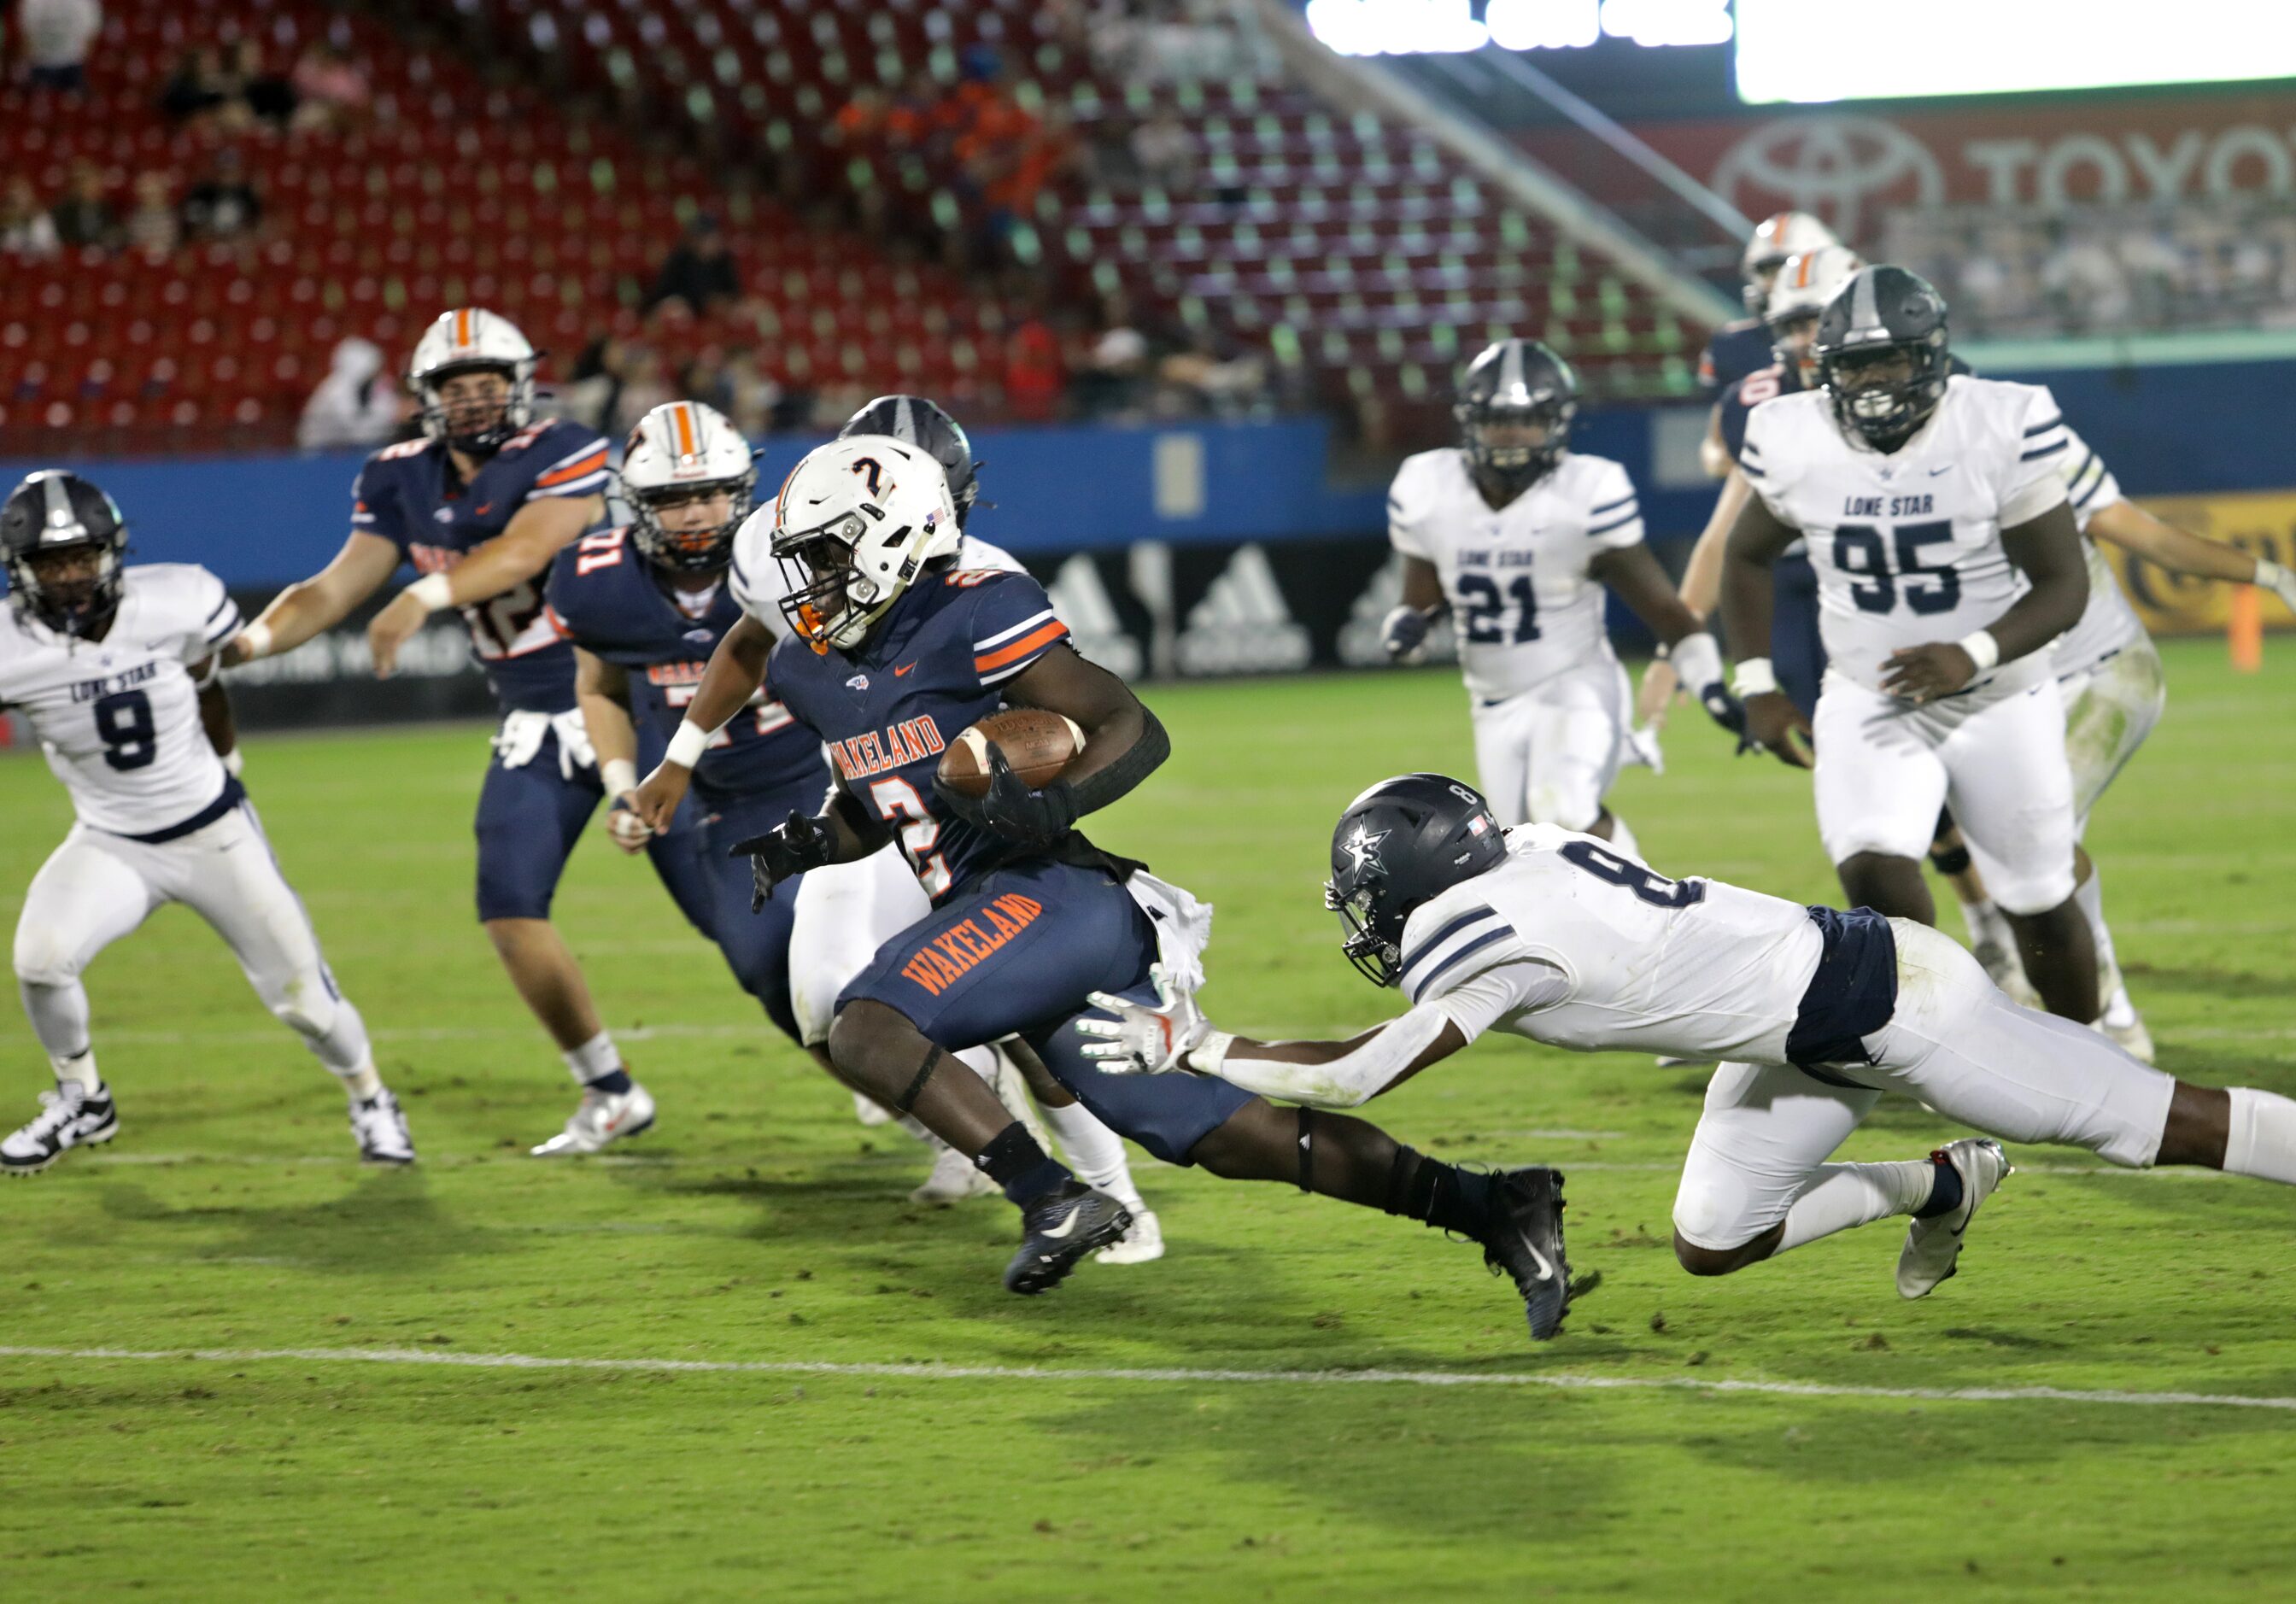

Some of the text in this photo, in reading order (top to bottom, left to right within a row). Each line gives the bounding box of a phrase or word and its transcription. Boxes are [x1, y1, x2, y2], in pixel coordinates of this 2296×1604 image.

[1965, 125, 2296, 208] TOYO
[852, 456, 896, 498] 2
[1844, 494, 1934, 516] LONE STAR
[1832, 519, 1962, 616] 95
[1457, 574, 1541, 644] 21
[94, 688, 157, 772] 9
[829, 714, 946, 781] WAKELAND
[1450, 784, 1479, 805] 8
[870, 776, 952, 900] 2
[1556, 840, 1707, 910] 8
[900, 893, 1043, 997] WAKELAND
